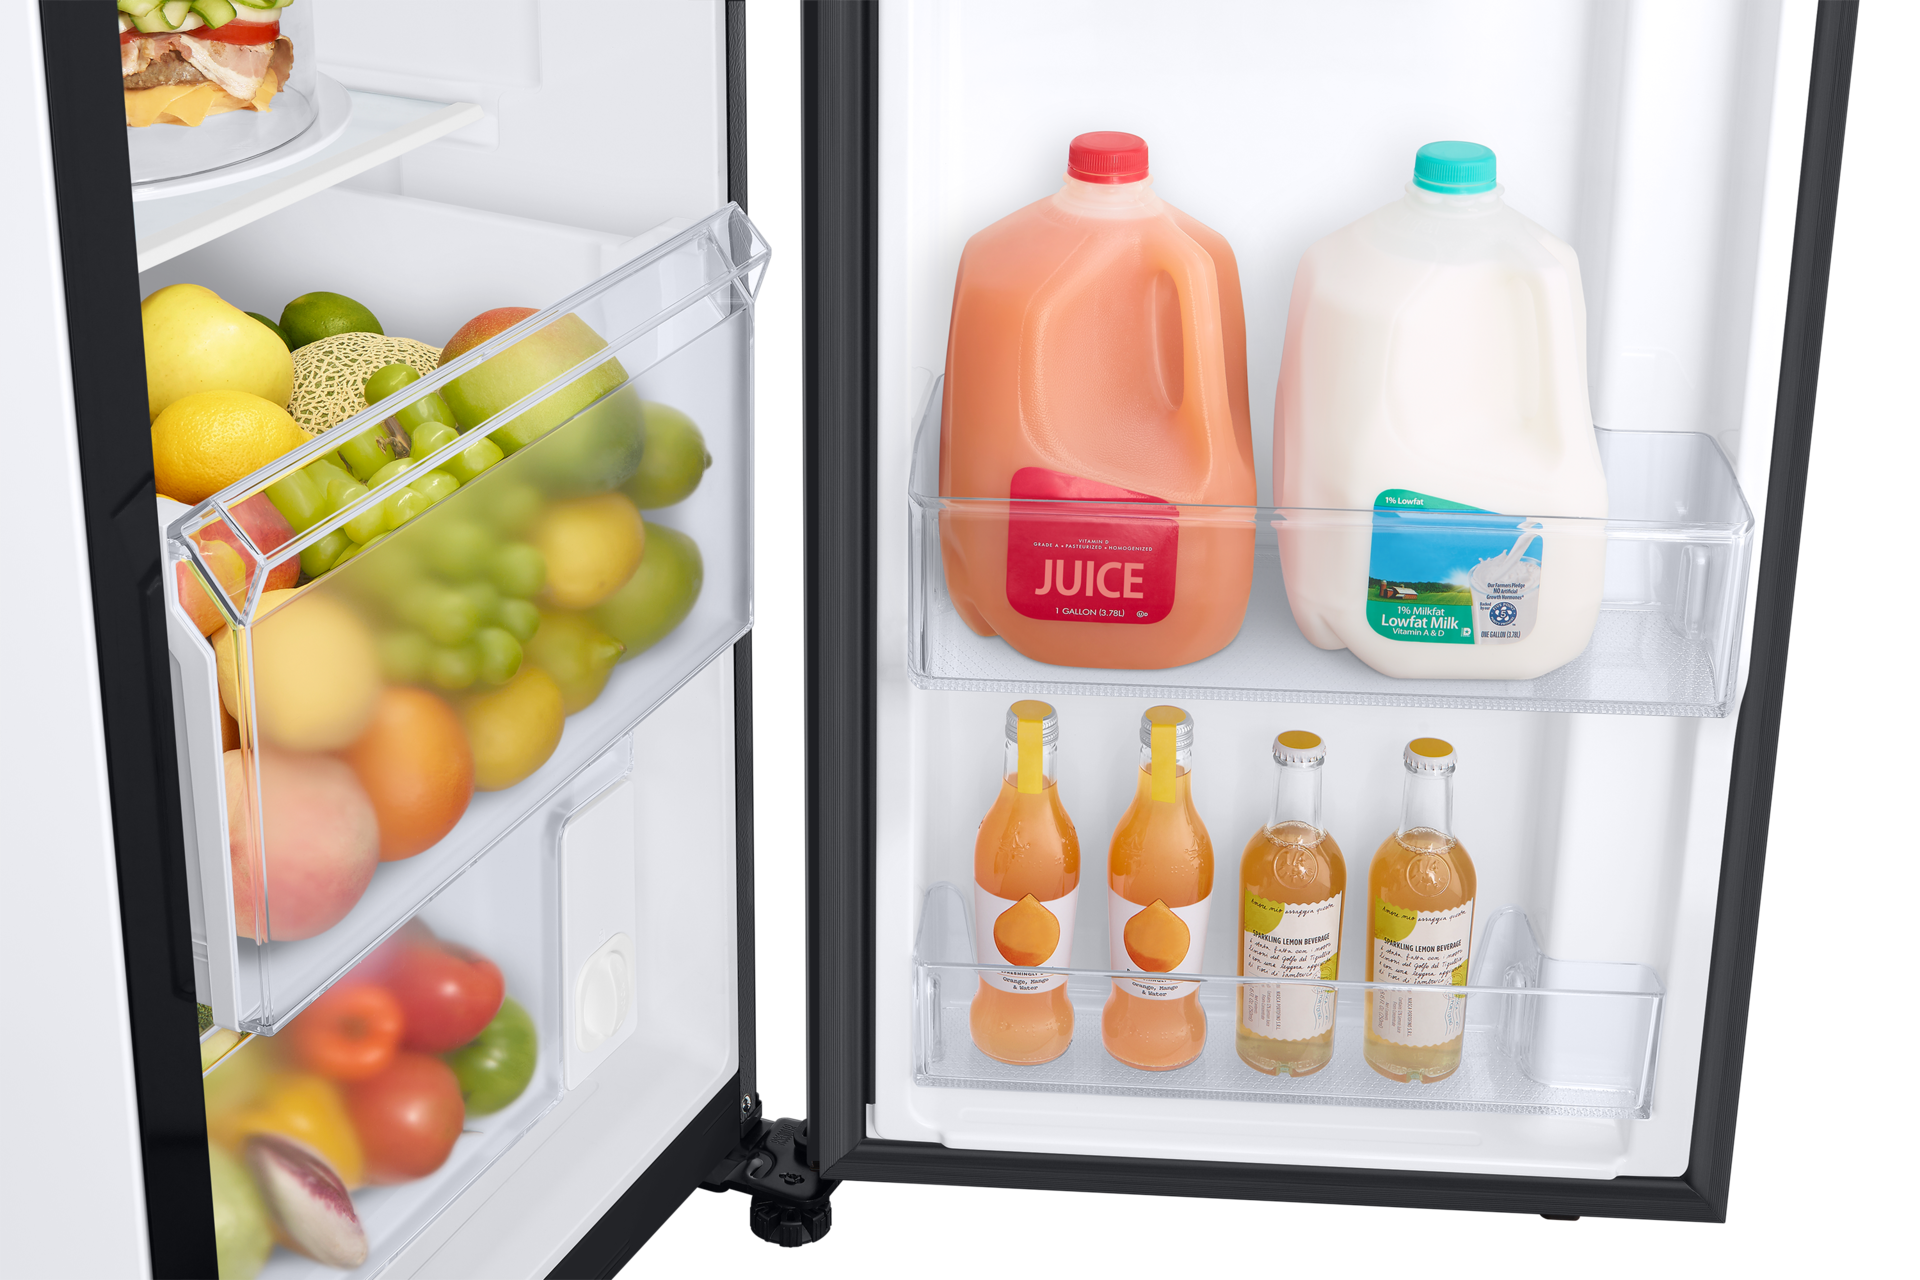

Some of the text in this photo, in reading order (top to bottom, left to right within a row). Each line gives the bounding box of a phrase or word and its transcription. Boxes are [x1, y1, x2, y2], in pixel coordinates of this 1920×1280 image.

[1398, 497, 1424, 505] Lowfat
[1035, 559, 1144, 599] JUICE
[1062, 608, 1097, 616] GALLON
[1099, 608, 1125, 617] (3.78L)
[1397, 606, 1445, 616] 1% Milkfat
[1381, 613, 1459, 630] Lowfat Milk
[1253, 929, 1281, 944] SPARKLING
[1304, 932, 1330, 945] BEVERAGE
[1384, 937, 1413, 952] SPARKLING
[1436, 939, 1461, 952] BEVERAGE
[1003, 977, 1027, 985] Orange,
[1132, 982, 1156, 991] Orange,
